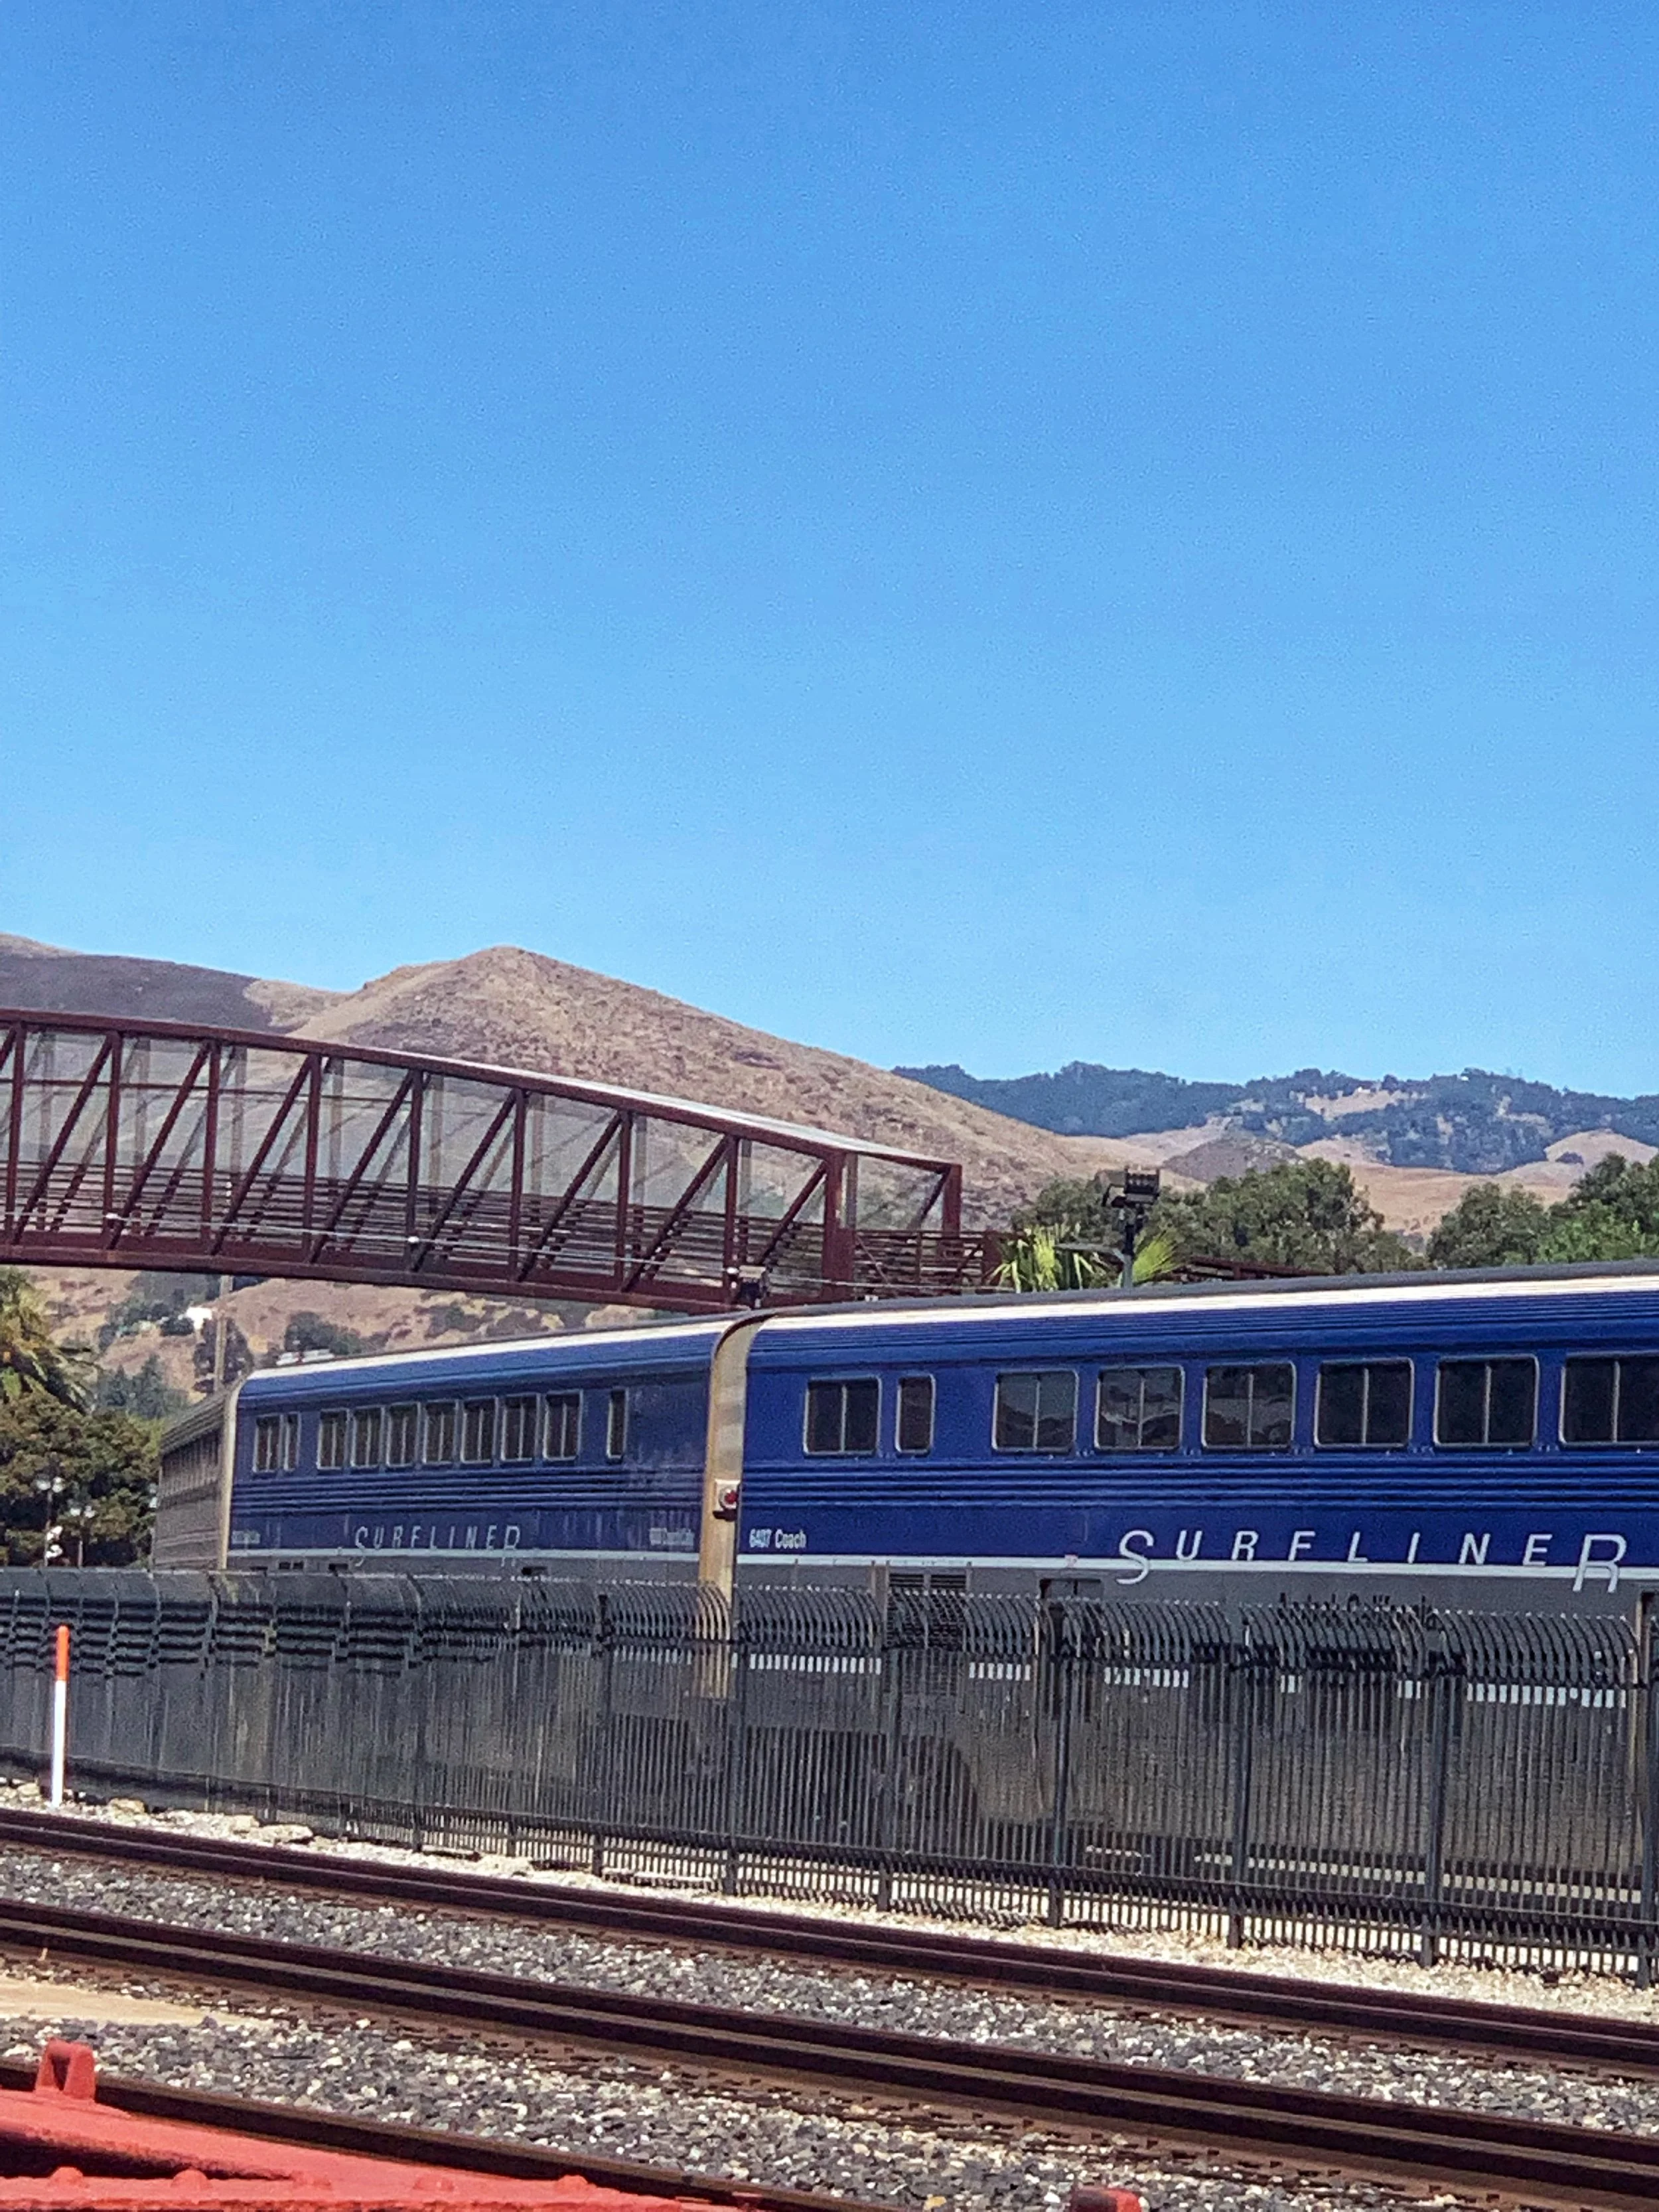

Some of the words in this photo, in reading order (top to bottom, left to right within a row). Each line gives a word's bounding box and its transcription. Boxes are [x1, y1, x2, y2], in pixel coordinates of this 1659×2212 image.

[355, 1525, 520, 1567] SURFLINER
[775, 1529, 806, 1548] Coach
[1117, 1530, 1626, 1593] SURFLINER
